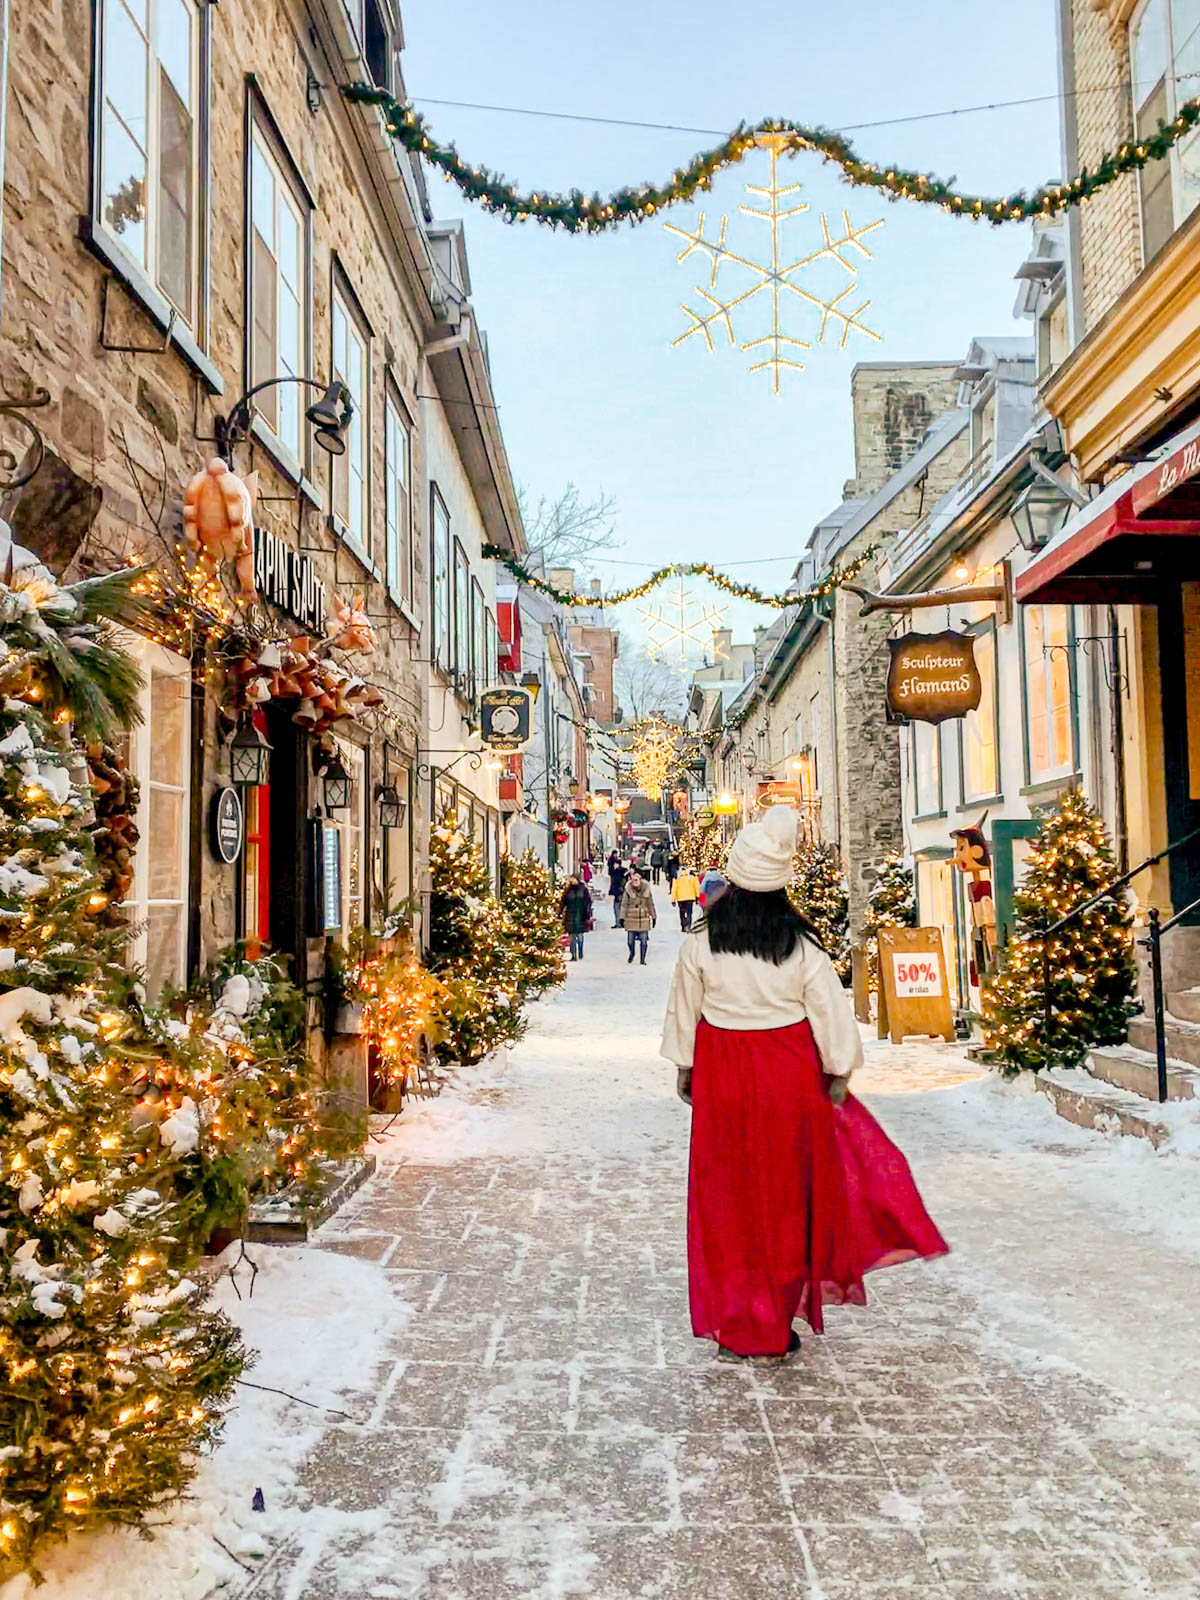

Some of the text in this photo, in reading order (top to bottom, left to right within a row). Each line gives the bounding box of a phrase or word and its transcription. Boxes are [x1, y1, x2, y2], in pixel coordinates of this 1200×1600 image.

[1158, 463, 1177, 496] La
[255, 527, 288, 609] APIN
[902, 655, 963, 671] Sculpteur
[899, 674, 970, 697] Flamand
[897, 963, 936, 982] 50%
